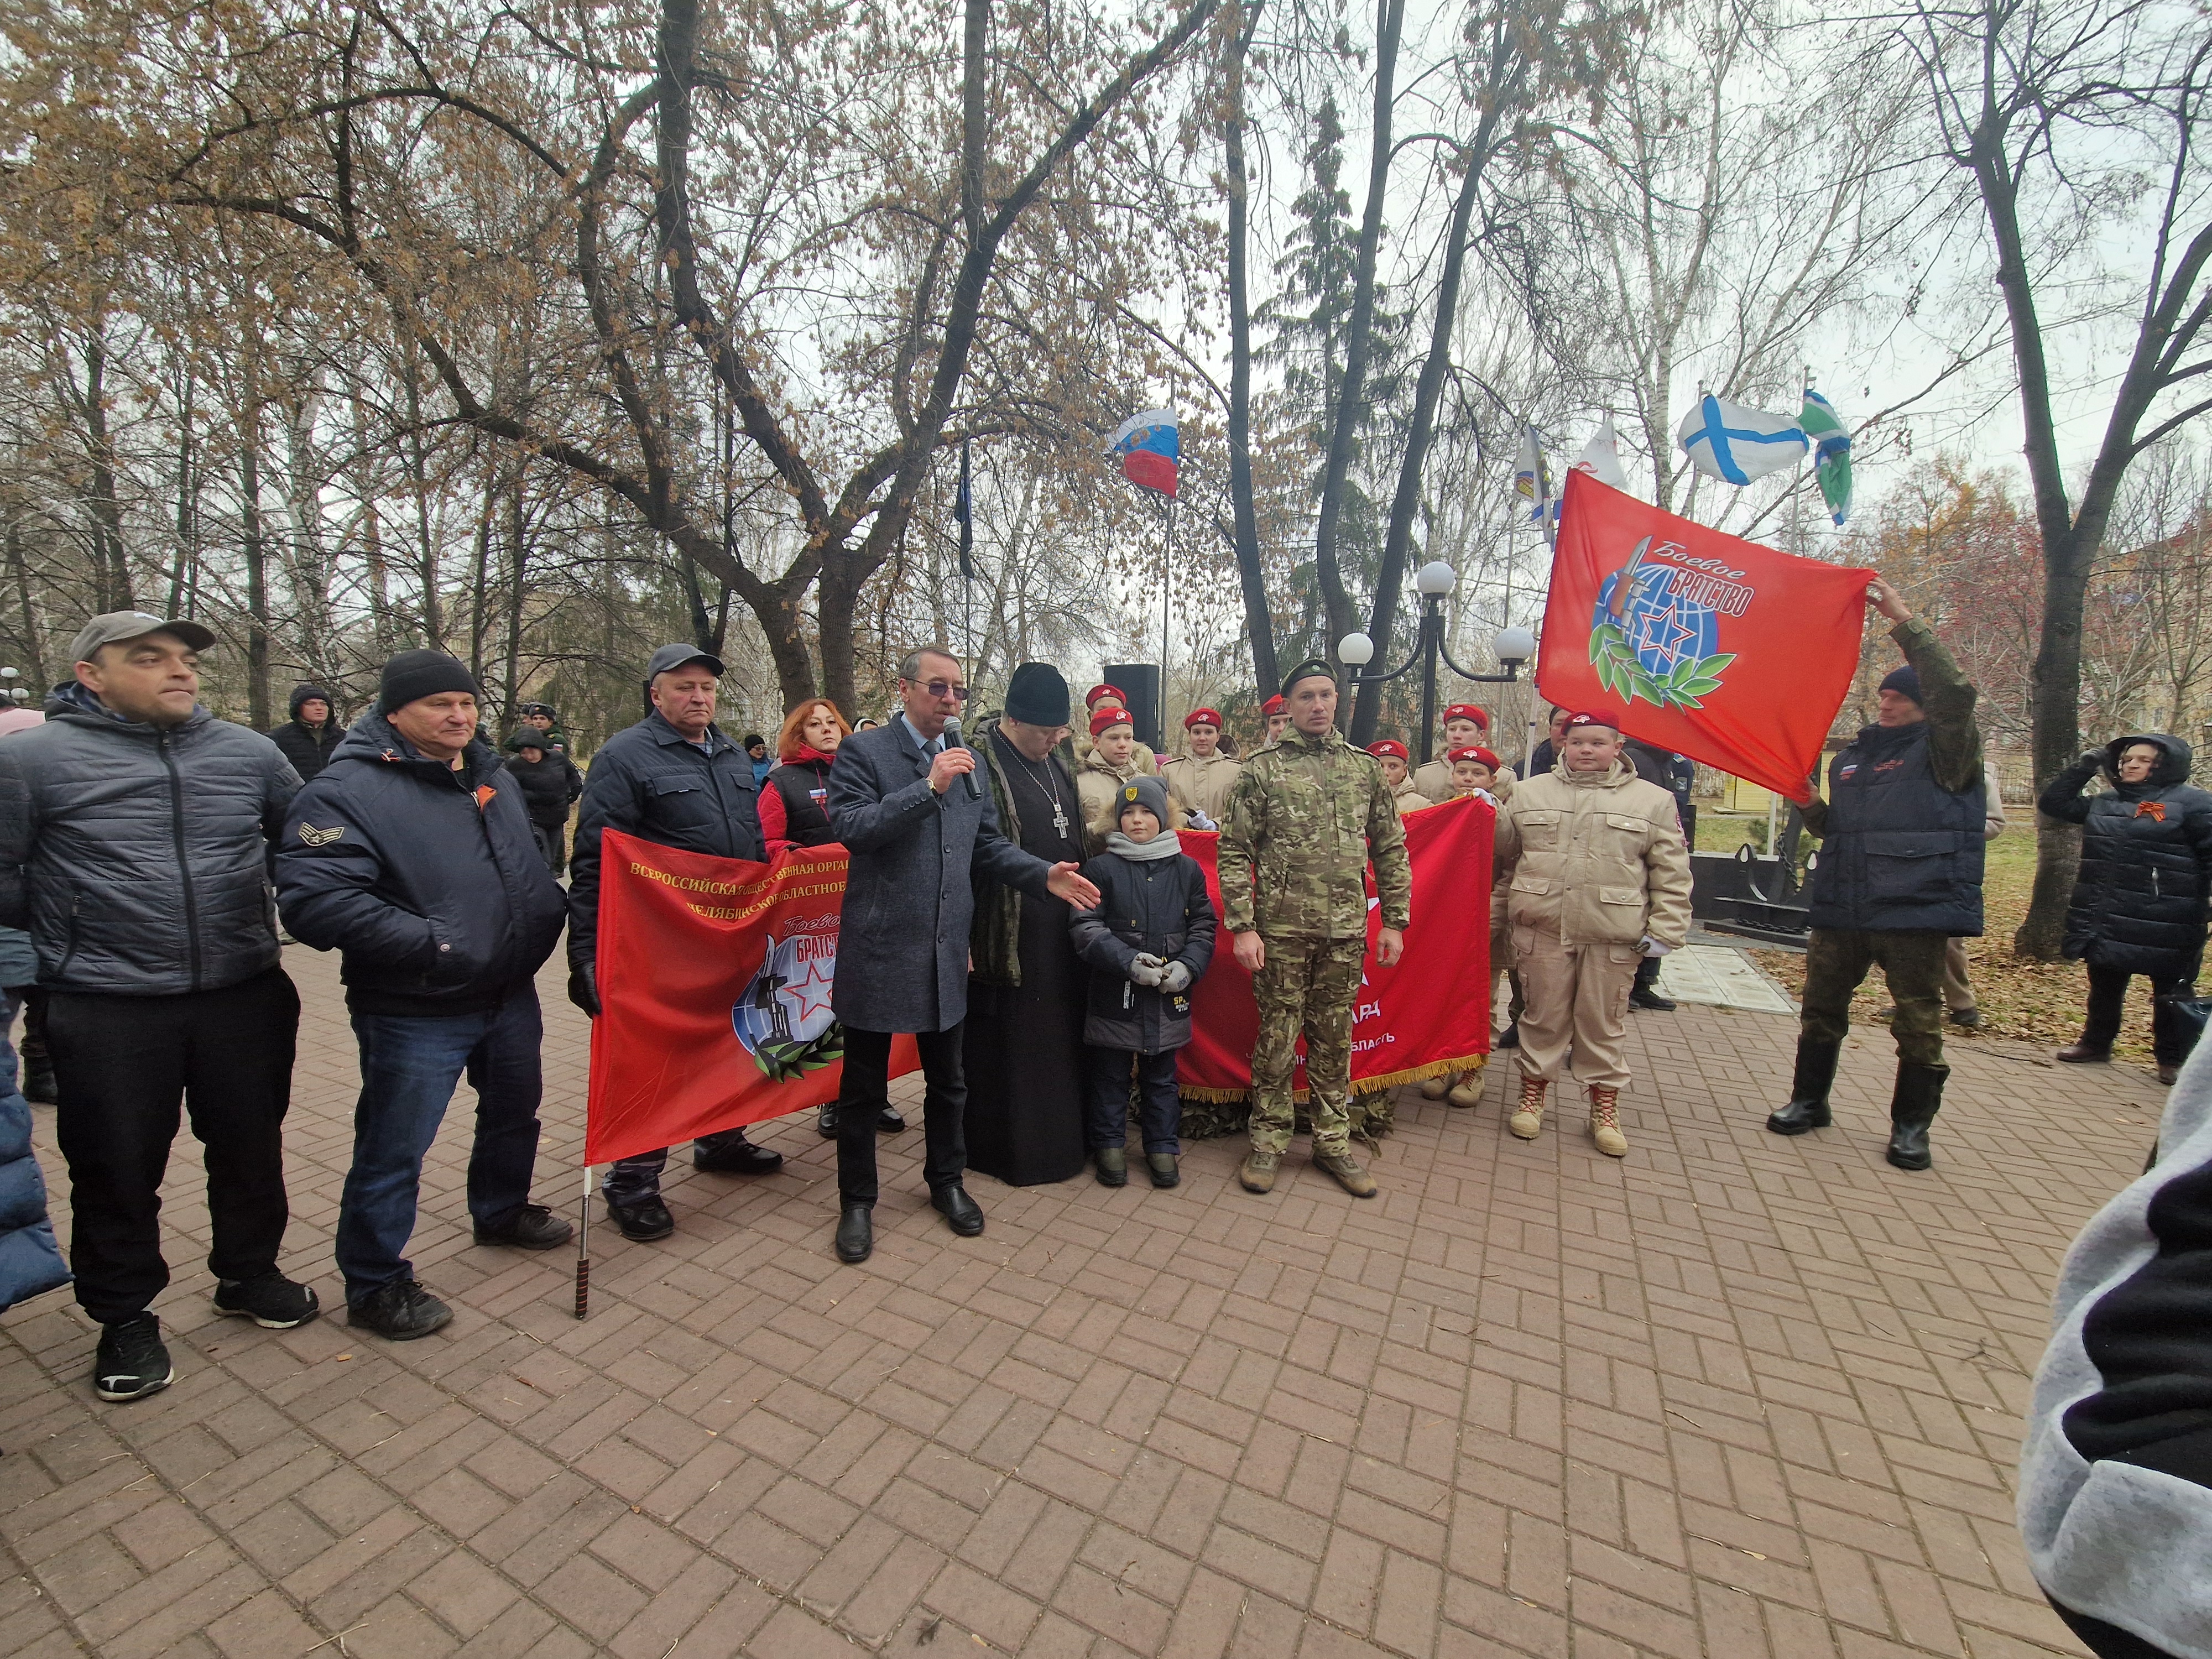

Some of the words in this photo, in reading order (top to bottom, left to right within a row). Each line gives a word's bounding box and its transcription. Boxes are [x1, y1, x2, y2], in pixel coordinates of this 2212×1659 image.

[1653, 540, 1746, 579] Боевое
[1667, 566, 1755, 618] БРАТСТВО
[629, 862, 744, 895] ВСЕРОССИЙСКАЯ
[743, 863, 815, 895] ОБЩЕСТВЕННАЯ
[686, 893, 779, 920] ЧЕЛЯБИНСКОЕ
[779, 880, 846, 902] ОБЛАСТНОЕ
[782, 912, 841, 937] Боево
[796, 932, 839, 964] БРАТСТ
[1351, 1032, 1395, 1052] БЛАСТЬ
